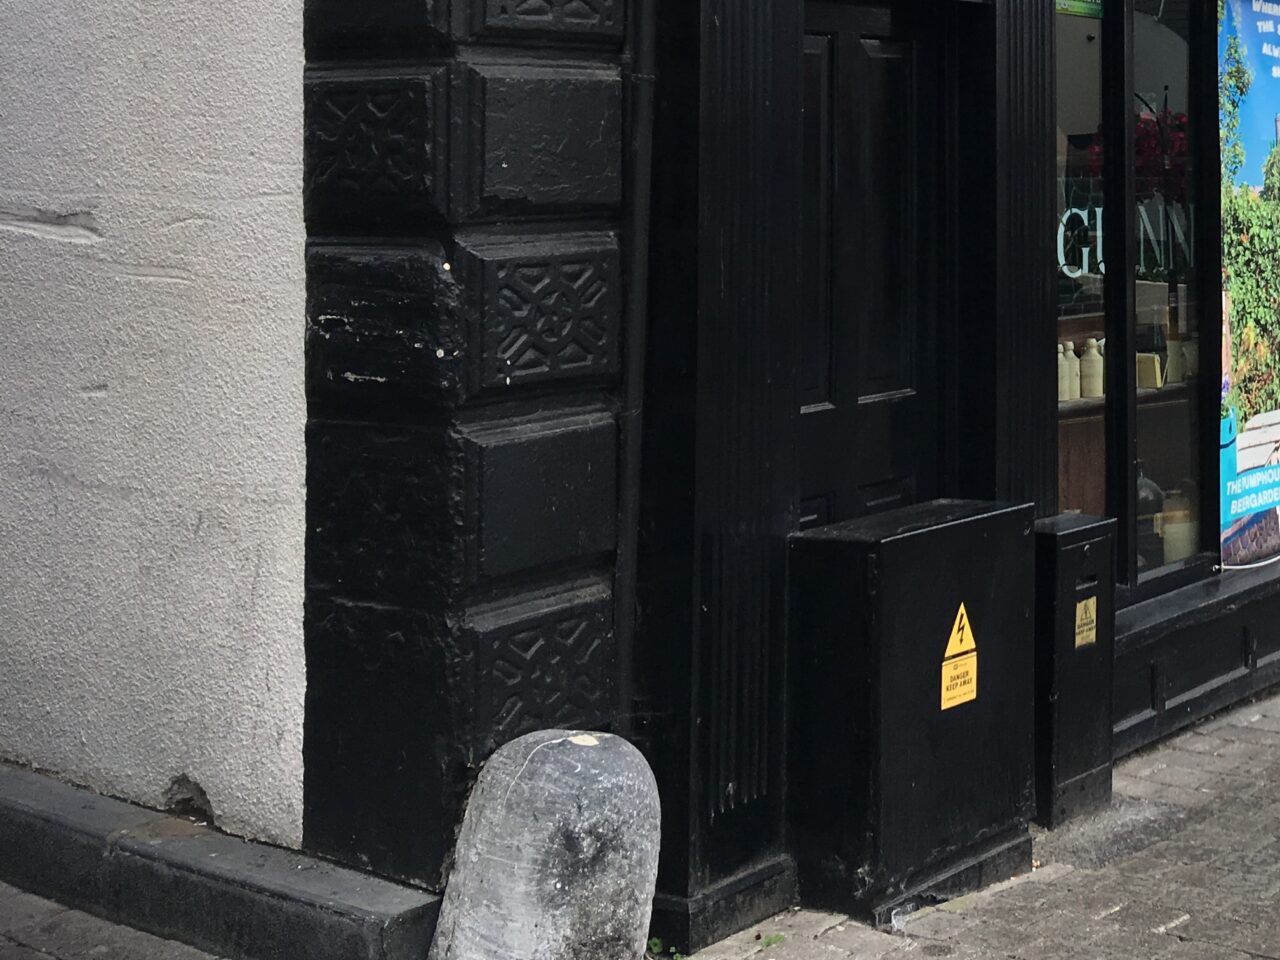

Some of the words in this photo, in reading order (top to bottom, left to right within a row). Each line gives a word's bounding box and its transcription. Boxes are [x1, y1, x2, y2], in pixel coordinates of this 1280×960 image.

[1257, 20, 1274, 33] THE
[1226, 476, 1242, 495] THE
[950, 671, 969, 683] DANGER
[946, 682, 958, 692] KEEP
[960, 677, 972, 687] AWAY
